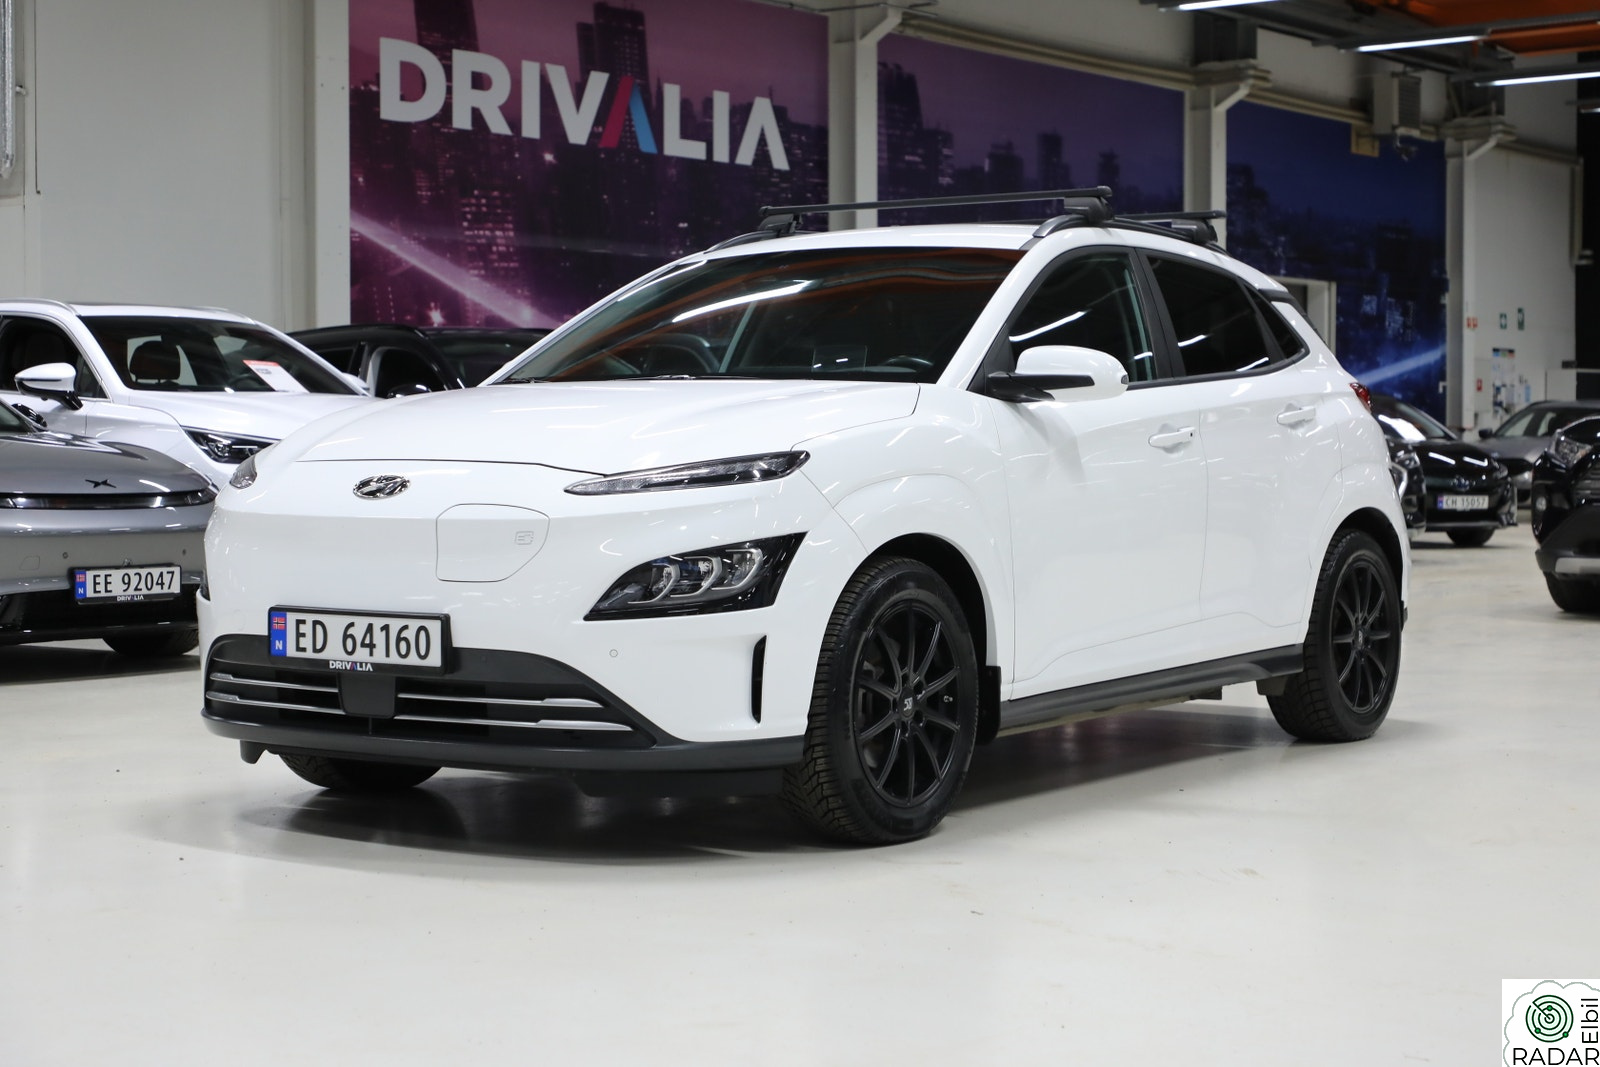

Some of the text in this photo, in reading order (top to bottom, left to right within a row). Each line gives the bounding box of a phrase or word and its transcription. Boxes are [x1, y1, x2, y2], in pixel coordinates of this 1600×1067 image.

[379, 36, 791, 172] DRIVALIA
[92, 570, 175, 594] EE 92047
[275, 639, 284, 651] N
[295, 618, 431, 660] ED 64160
[329, 660, 373, 672] DRIVALIA
